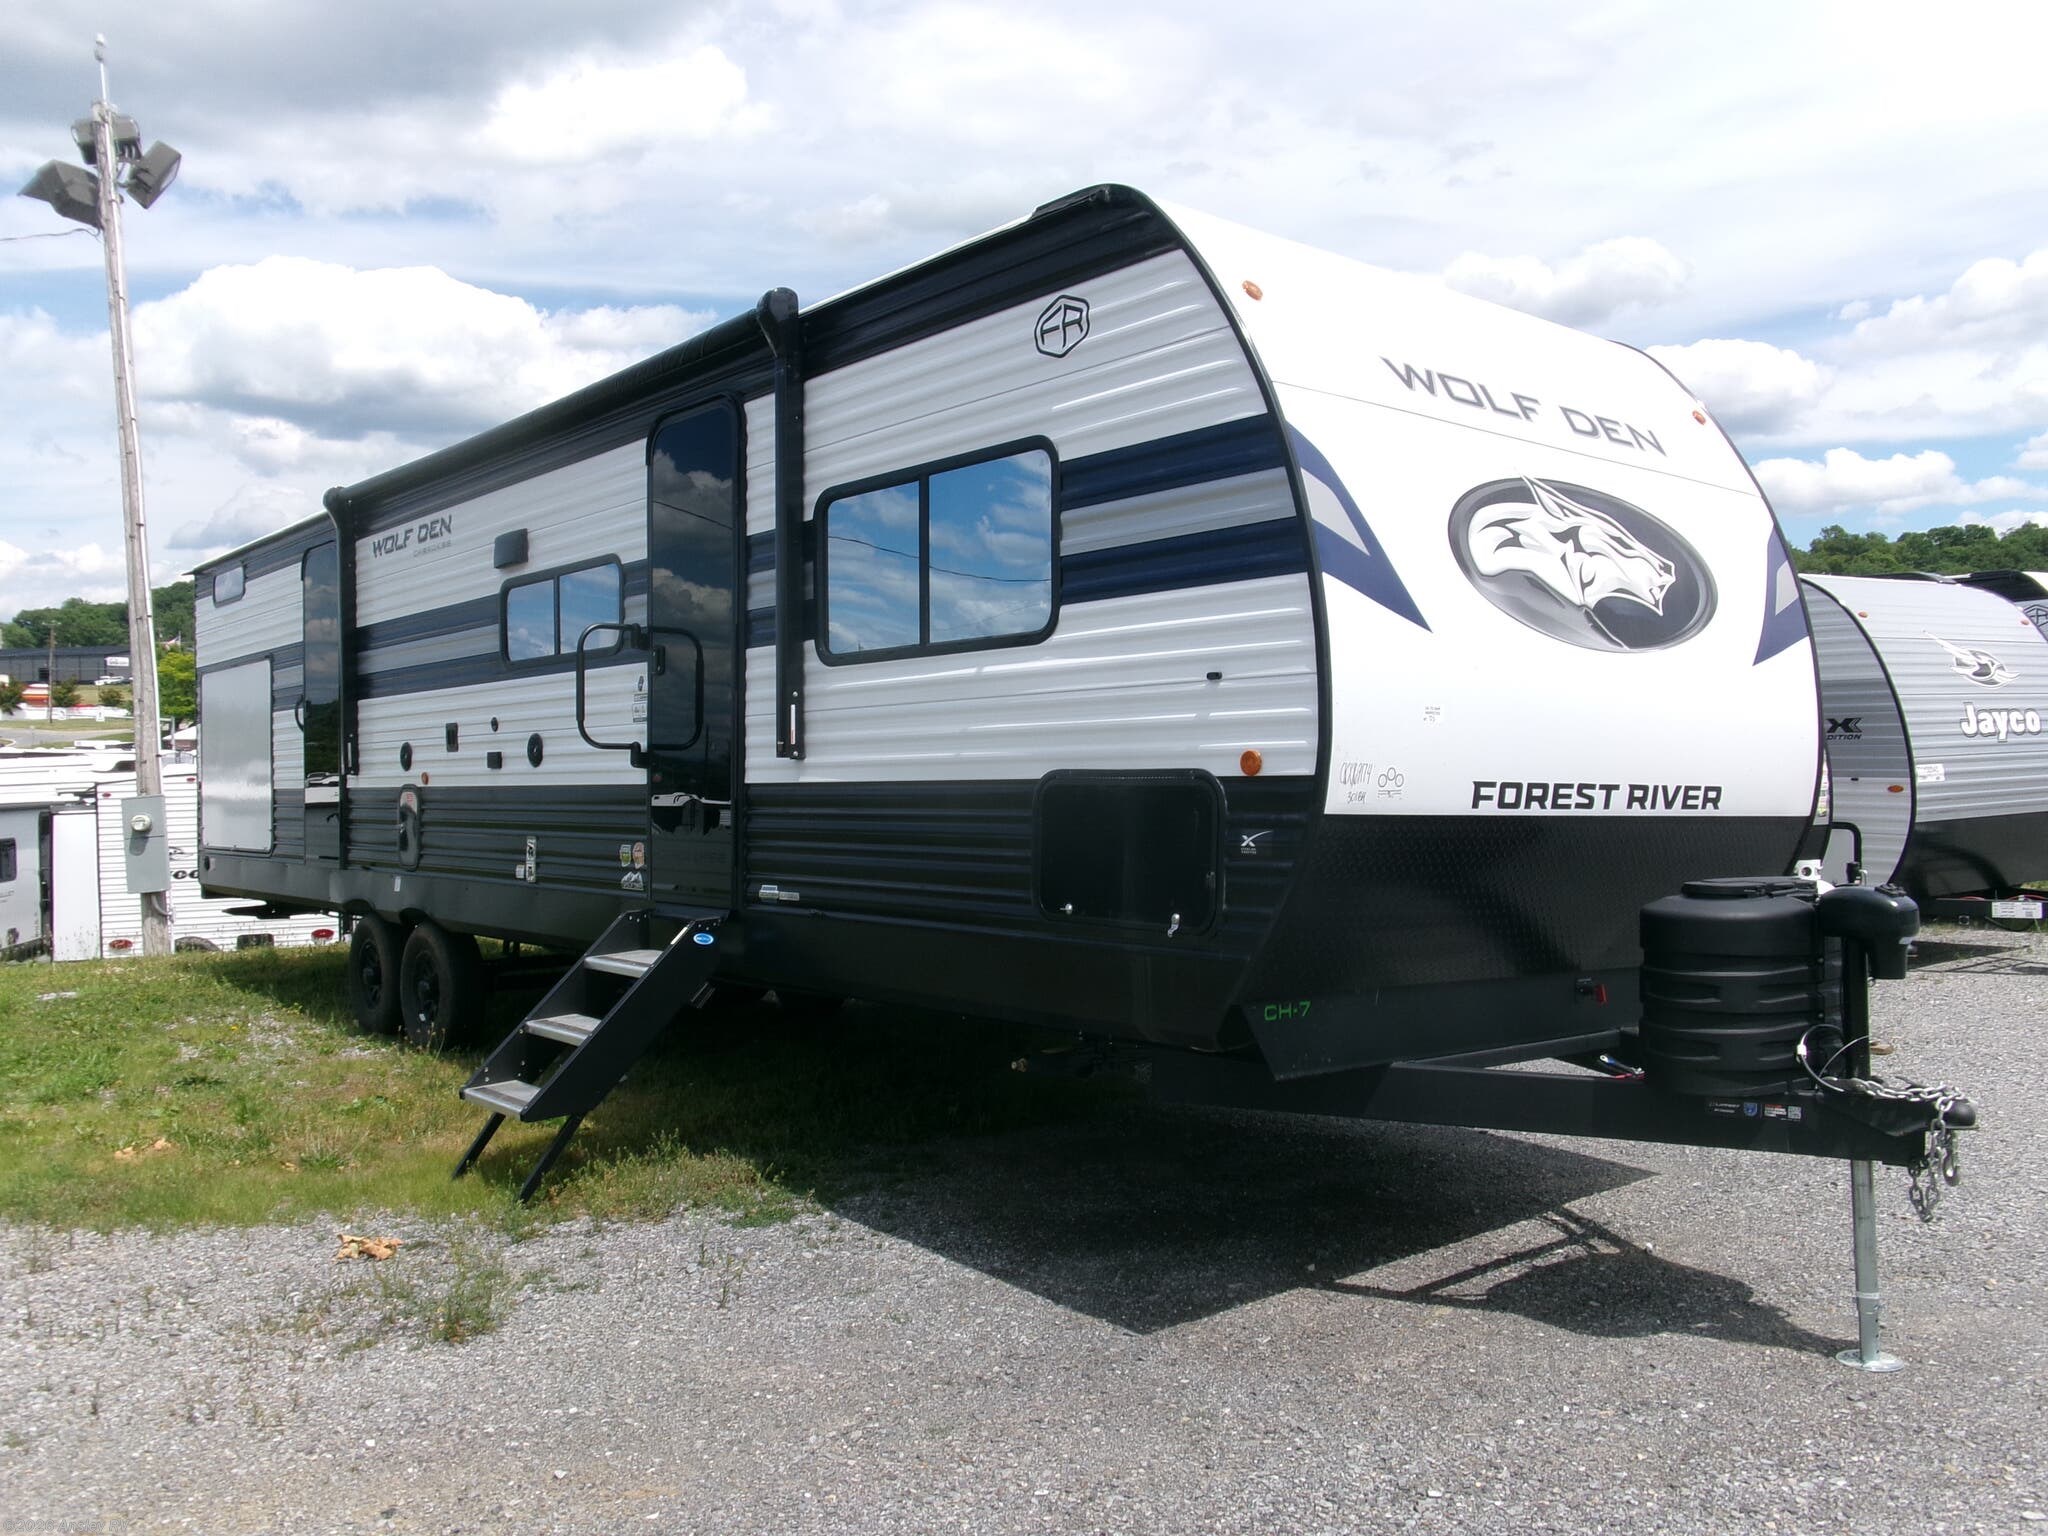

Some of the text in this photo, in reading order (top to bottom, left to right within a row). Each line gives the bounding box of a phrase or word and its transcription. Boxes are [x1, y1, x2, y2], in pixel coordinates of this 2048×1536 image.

[1379, 355, 1667, 456] WOLF DEN
[372, 514, 452, 558] WOLF DEN
[1960, 702, 2042, 742] Jayco
[1471, 781, 1723, 811] FOREST RIVER
